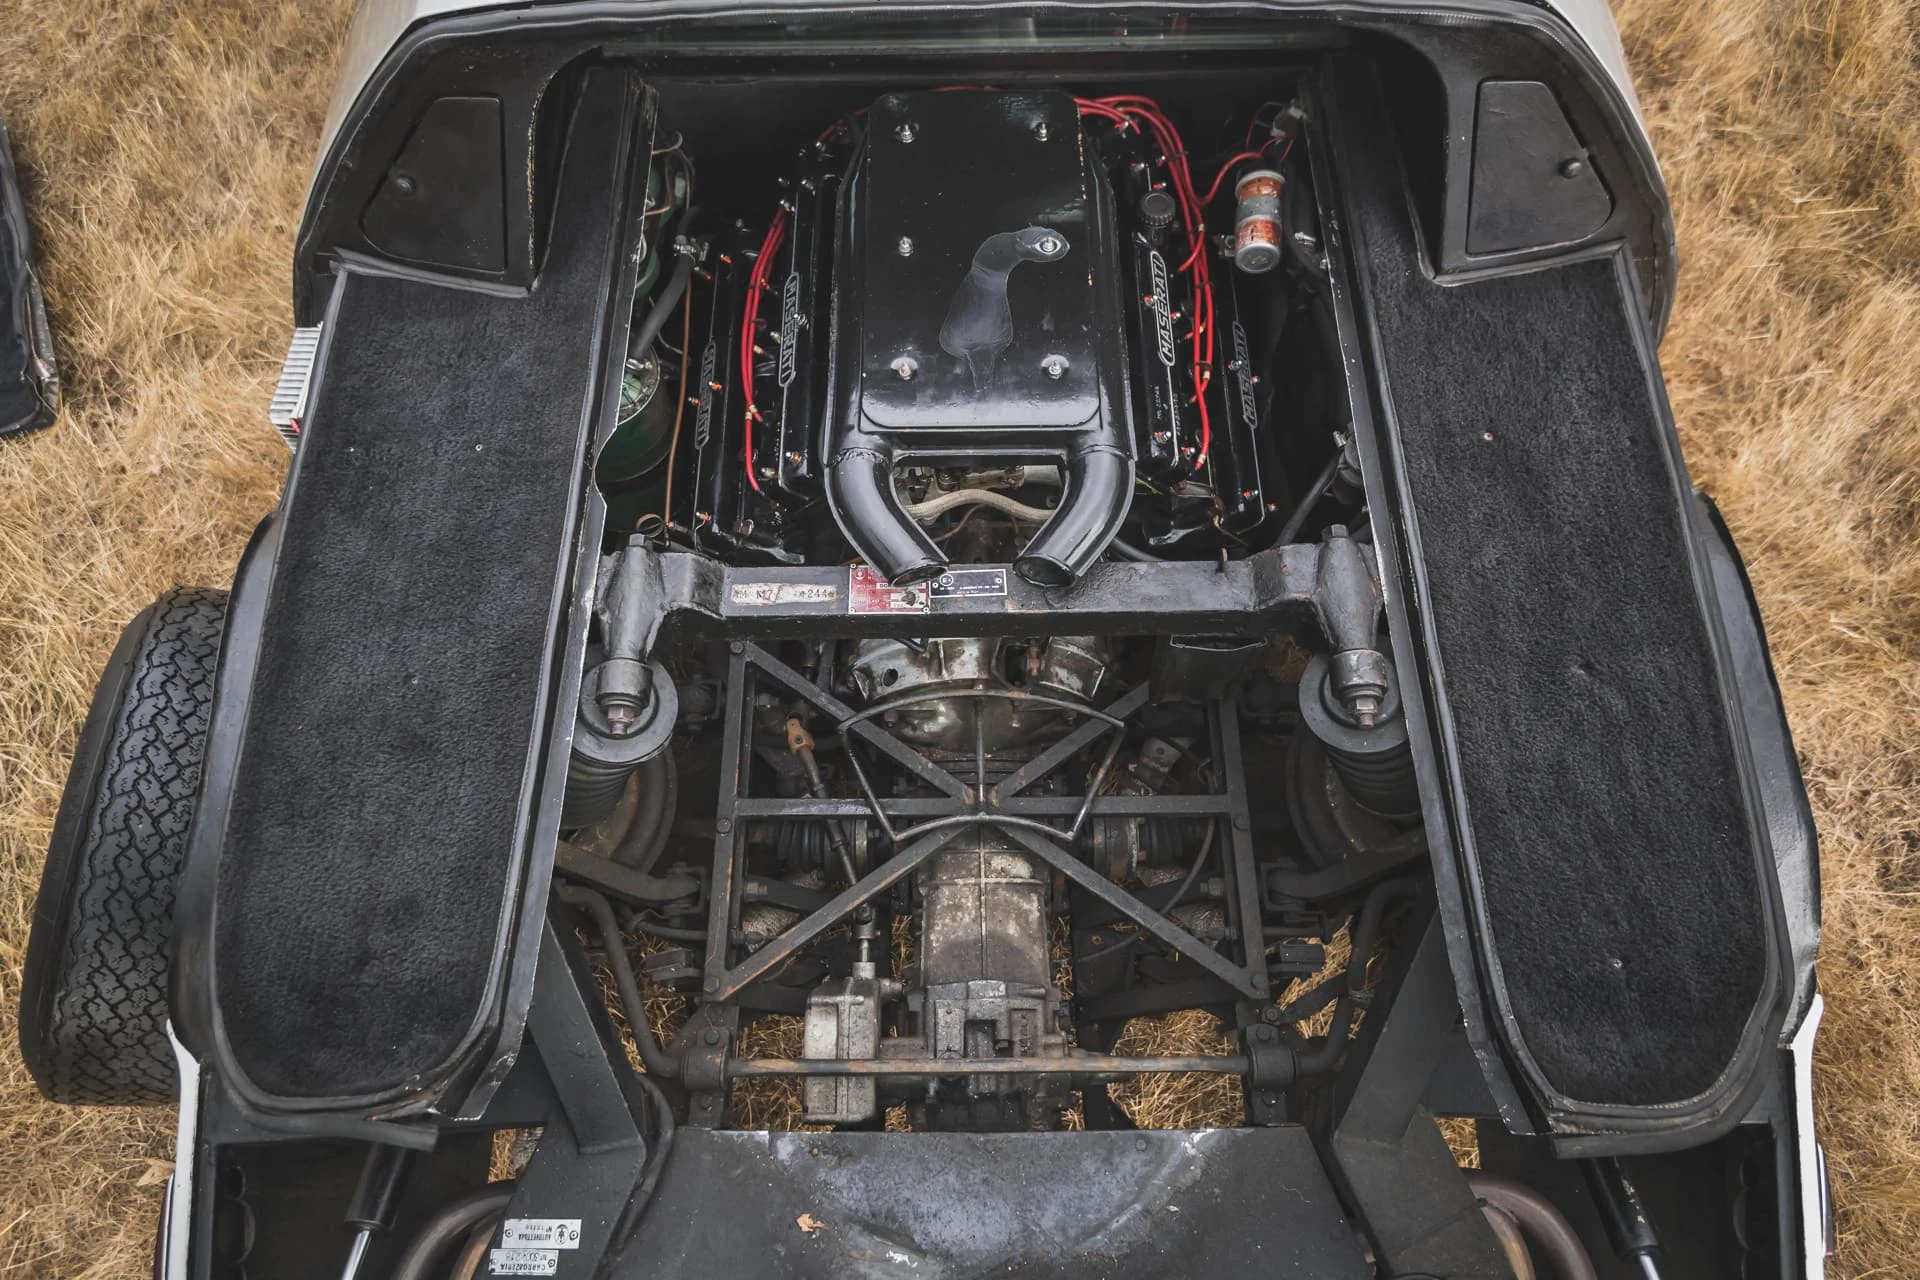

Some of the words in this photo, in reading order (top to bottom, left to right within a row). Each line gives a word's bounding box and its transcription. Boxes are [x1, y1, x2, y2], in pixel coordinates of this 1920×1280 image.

[780, 281, 798, 383] MASERATI
[1152, 256, 1174, 361] MASERATI
[696, 349, 715, 445] MASERATI
[1234, 325, 1257, 424] MASERATI
[500, 1263, 546, 1271] CARROZZERIA
